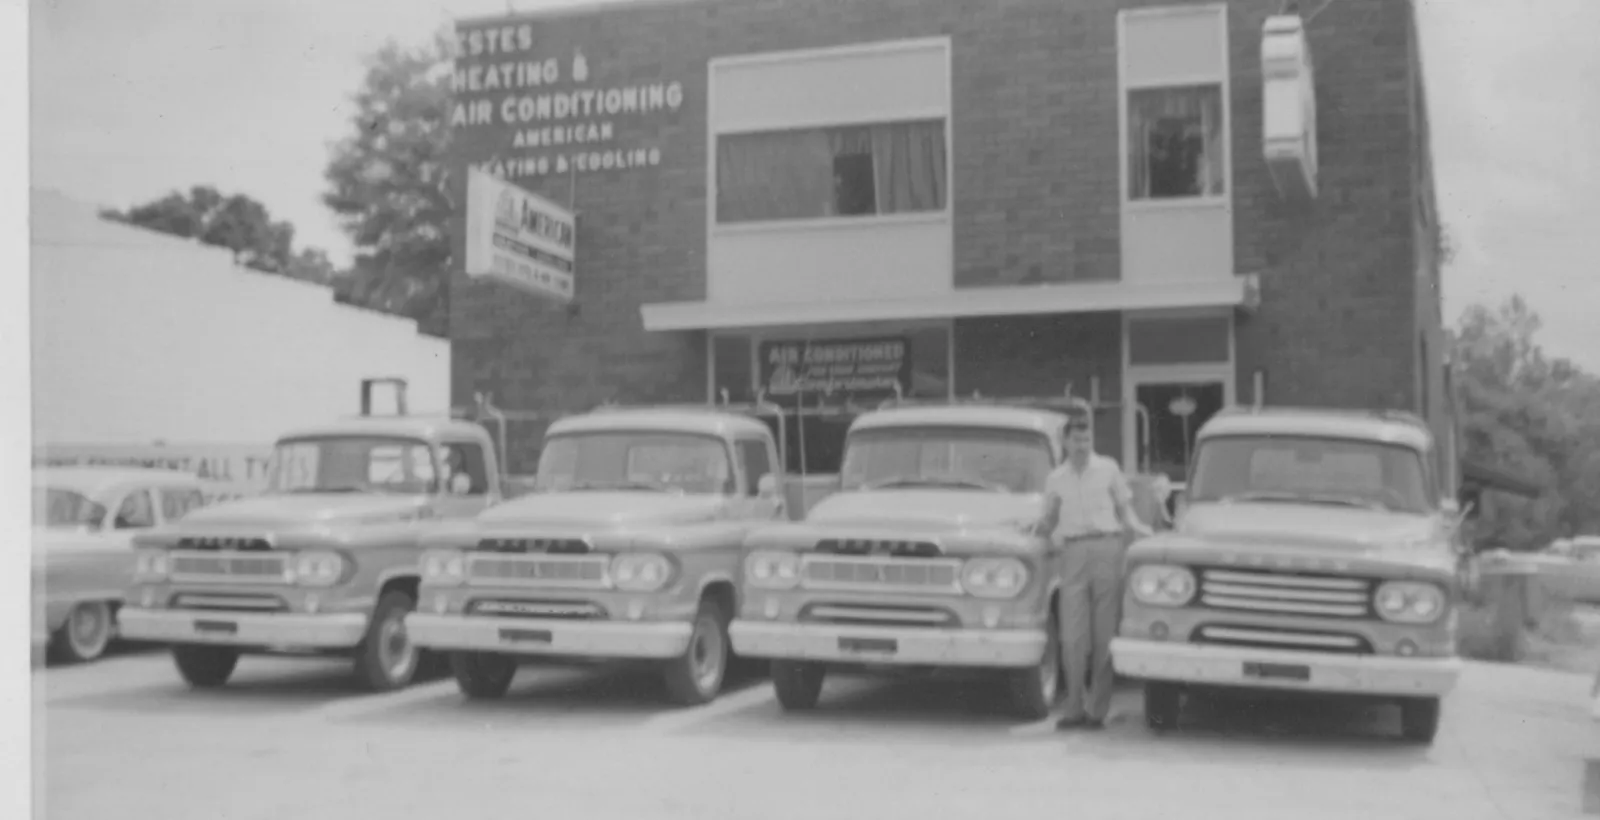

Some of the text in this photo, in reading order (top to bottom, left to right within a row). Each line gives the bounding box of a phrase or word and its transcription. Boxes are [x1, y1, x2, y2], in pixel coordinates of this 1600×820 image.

[454, 24, 532, 58] ESTES
[452, 57, 559, 93] HEATING
[452, 80, 683, 127] AIR CONDITIONING
[513, 121, 613, 148] AMERICAN
[577, 148, 660, 173] COOLING
[198, 456, 233, 482] ALL
